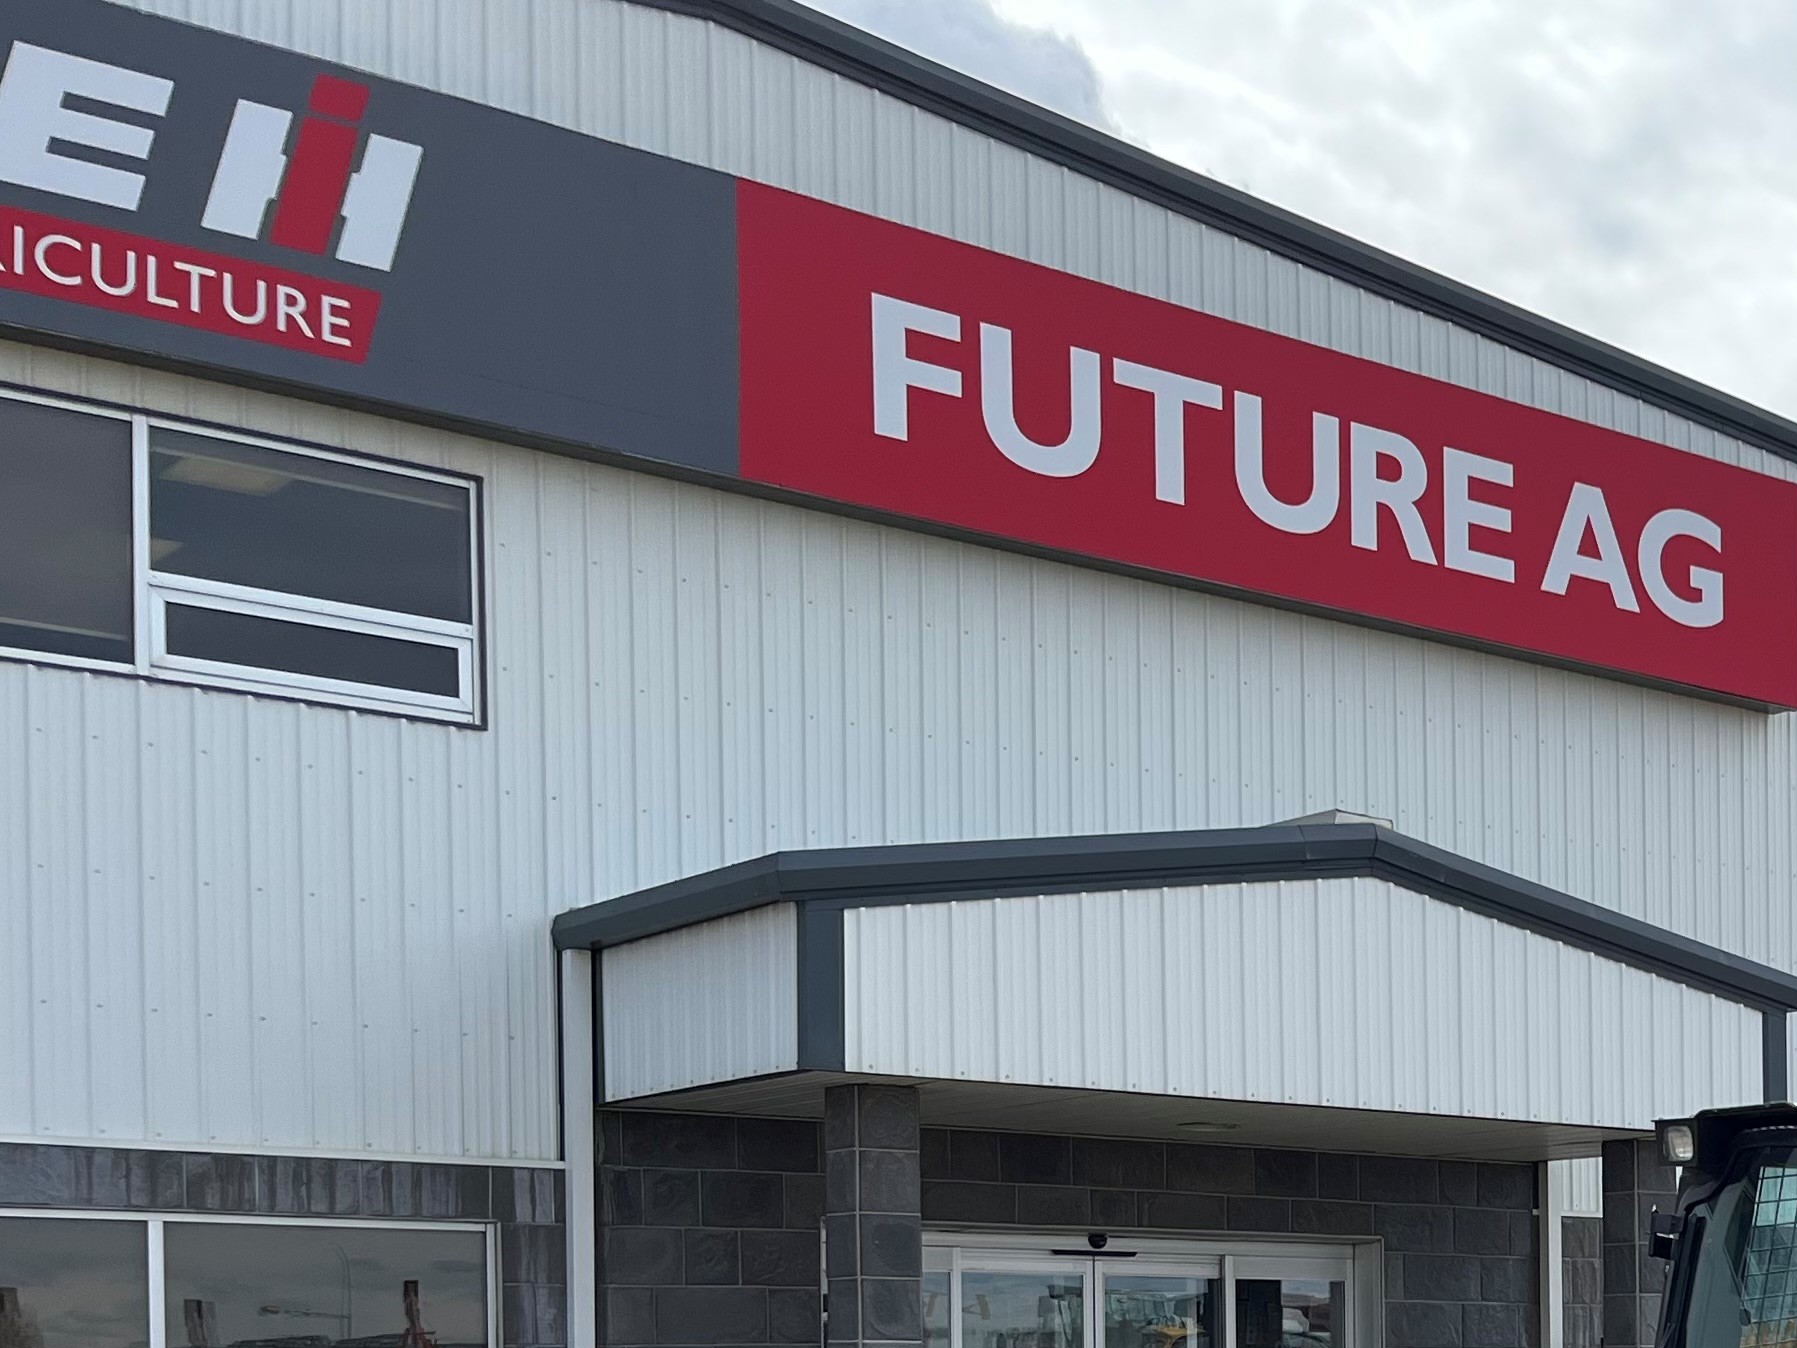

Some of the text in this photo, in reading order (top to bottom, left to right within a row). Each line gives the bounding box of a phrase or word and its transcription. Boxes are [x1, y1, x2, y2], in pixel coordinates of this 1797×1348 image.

[0, 225, 352, 348] ICULTURE
[871, 292, 1724, 628] FUTURE AG
